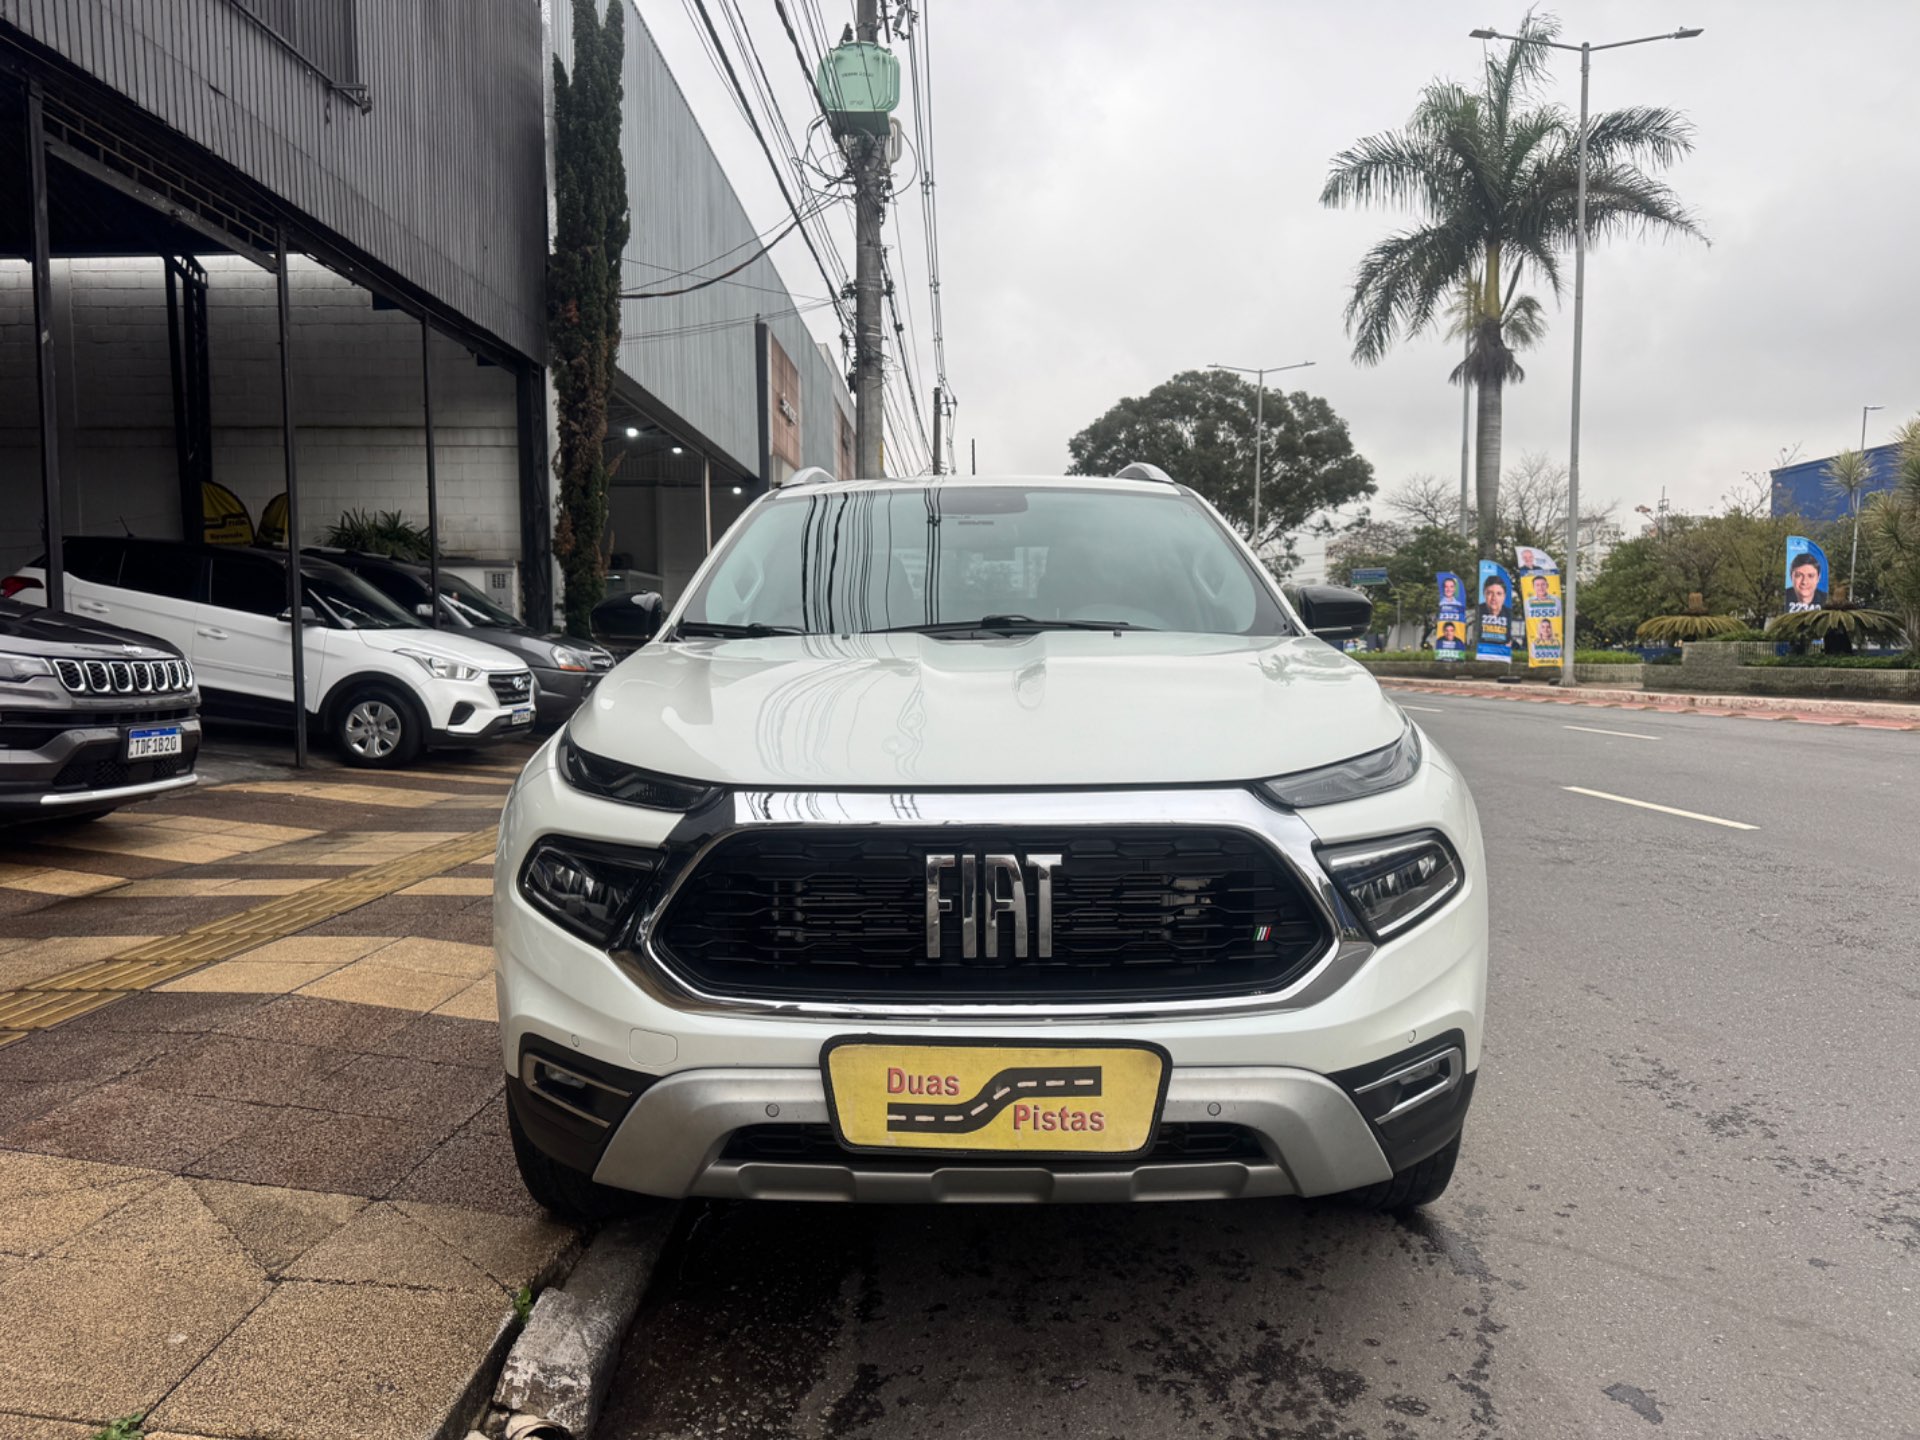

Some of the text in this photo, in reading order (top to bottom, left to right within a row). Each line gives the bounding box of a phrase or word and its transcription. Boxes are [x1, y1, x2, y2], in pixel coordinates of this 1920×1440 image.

[135, 736, 177, 756] TDF1B20
[926, 854, 1063, 959] FIAT
[887, 1067, 960, 1097] Duas
[1012, 1104, 1105, 1132] Pistas
